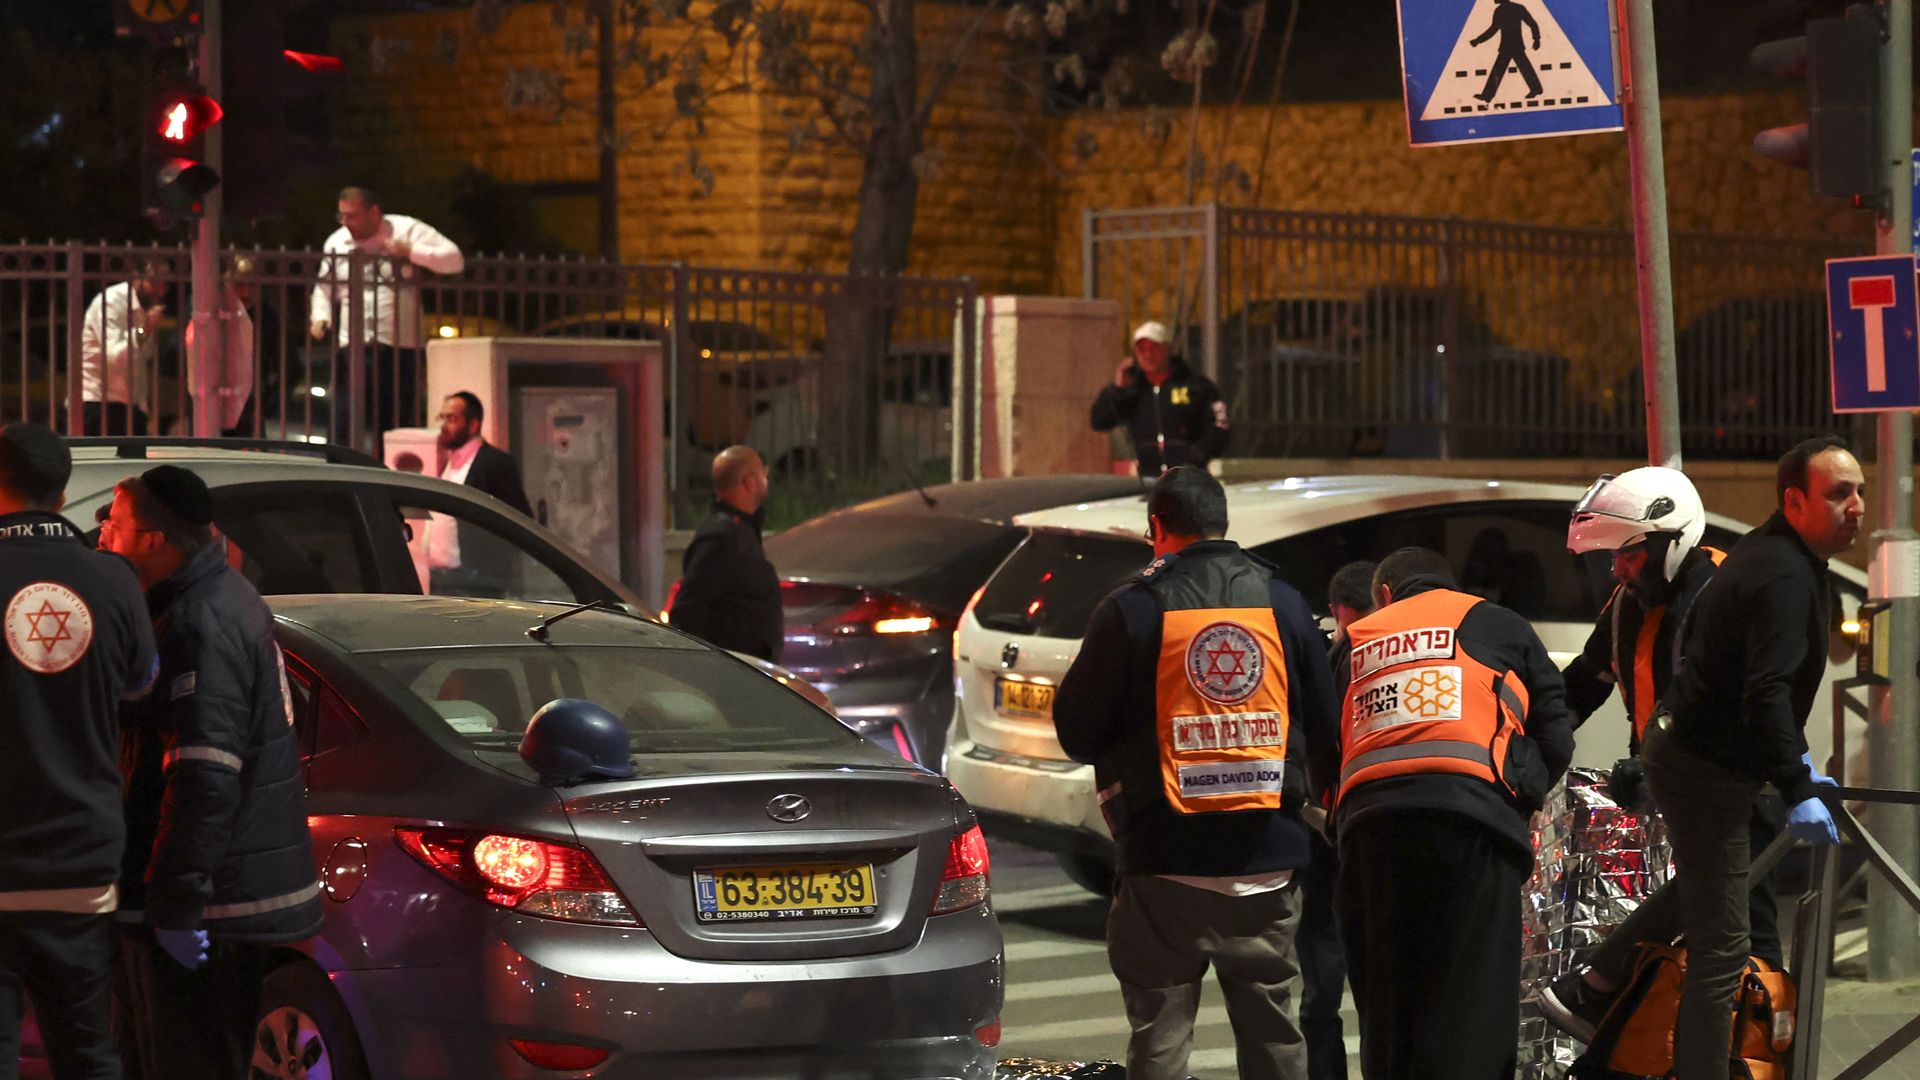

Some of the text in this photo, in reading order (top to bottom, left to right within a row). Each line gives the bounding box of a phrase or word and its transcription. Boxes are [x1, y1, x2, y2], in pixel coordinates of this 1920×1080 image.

[1352, 630, 1450, 681] פראמדיק
[1184, 771, 1280, 787] MAGEN DAVID ADOM
[716, 911, 769, 919] 02-5380340
